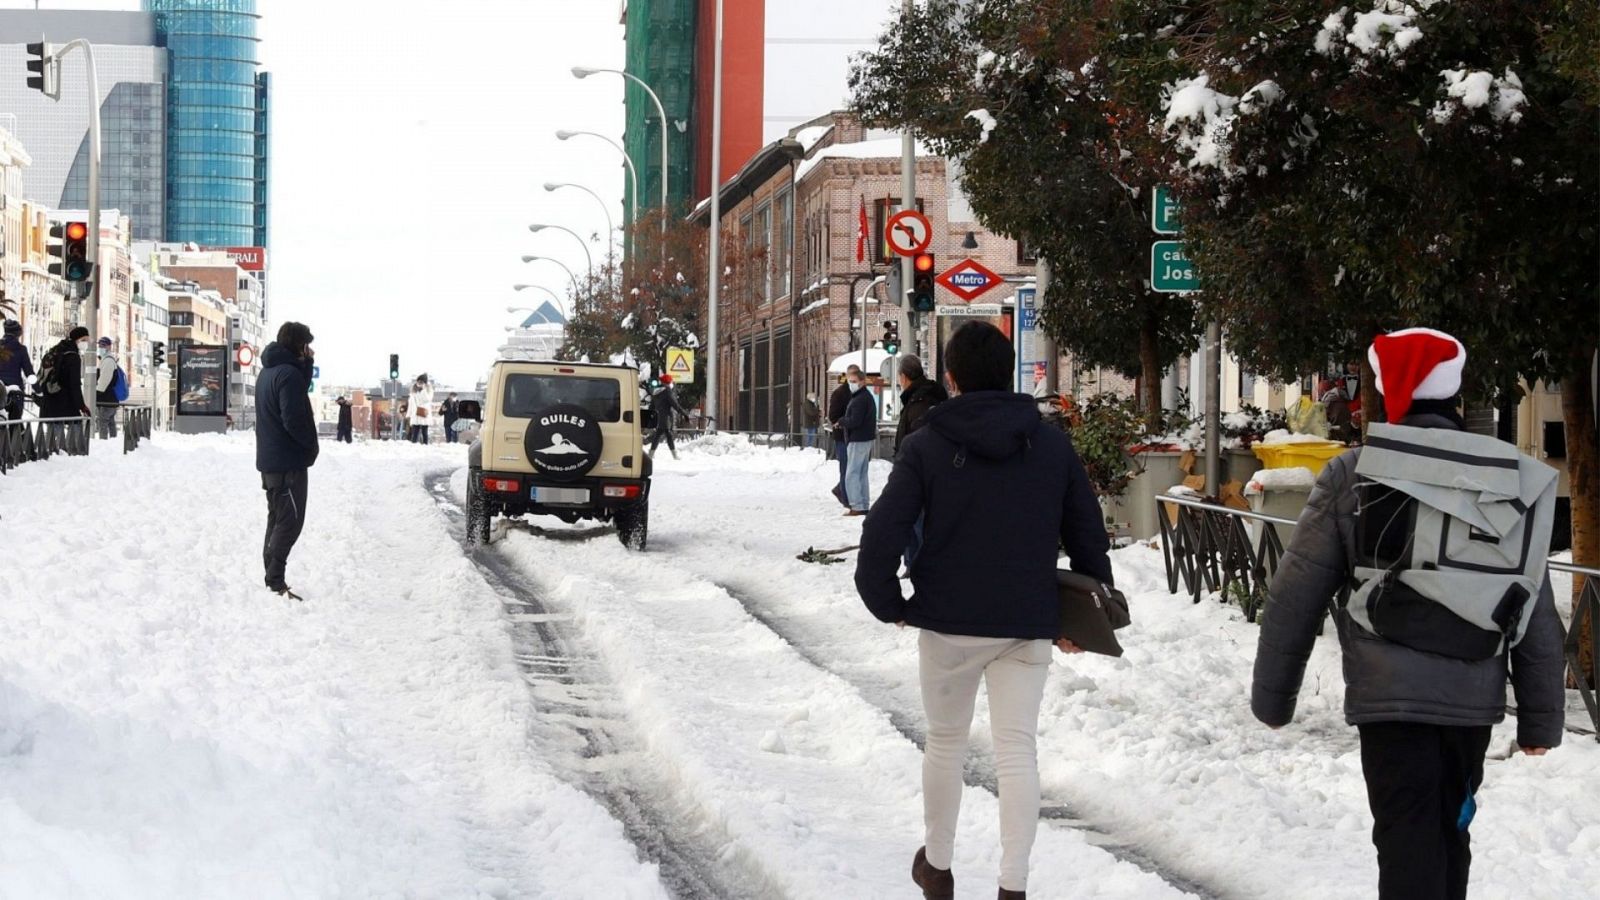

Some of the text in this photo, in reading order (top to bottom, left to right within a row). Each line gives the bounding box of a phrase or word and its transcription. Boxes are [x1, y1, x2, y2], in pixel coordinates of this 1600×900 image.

[235, 252, 257, 263] RALI
[1162, 265, 1195, 280] Jos
[954, 274, 985, 285] Metro
[1025, 309, 1034, 317] 45
[541, 414, 586, 428] QUILES
[534, 458, 588, 472] www.quiles-auto.com
